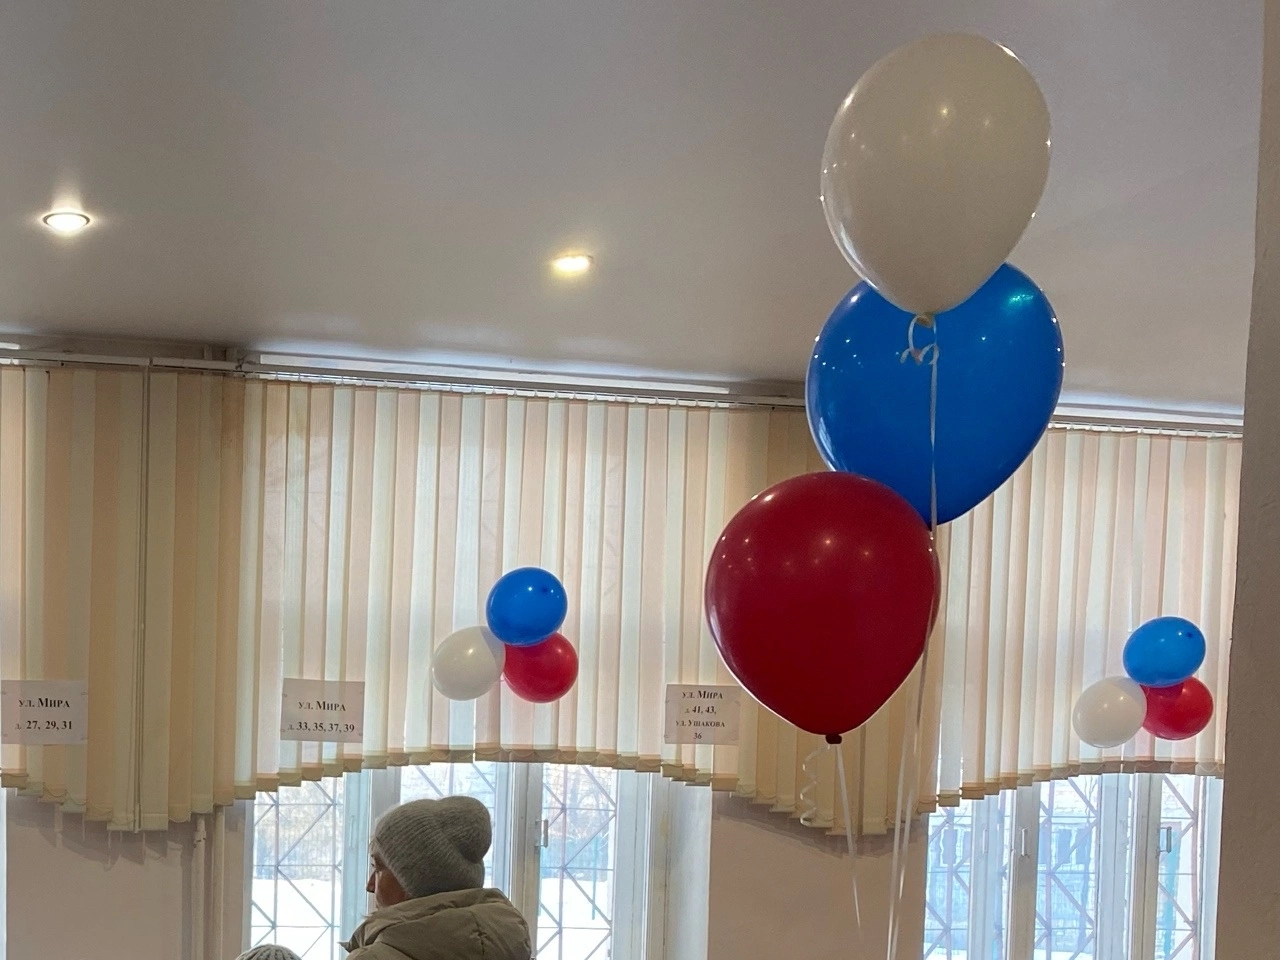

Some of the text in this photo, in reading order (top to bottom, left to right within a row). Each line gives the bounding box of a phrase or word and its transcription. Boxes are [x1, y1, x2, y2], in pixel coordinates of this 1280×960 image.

[26, 721, 41, 730] 27,
[45, 721, 60, 730] 29,
[61, 721, 72, 730] 31
[296, 722, 311, 732] 33,
[313, 722, 327, 732] 35,
[328, 723, 342, 733] 37,
[343, 724, 355, 732] 39
